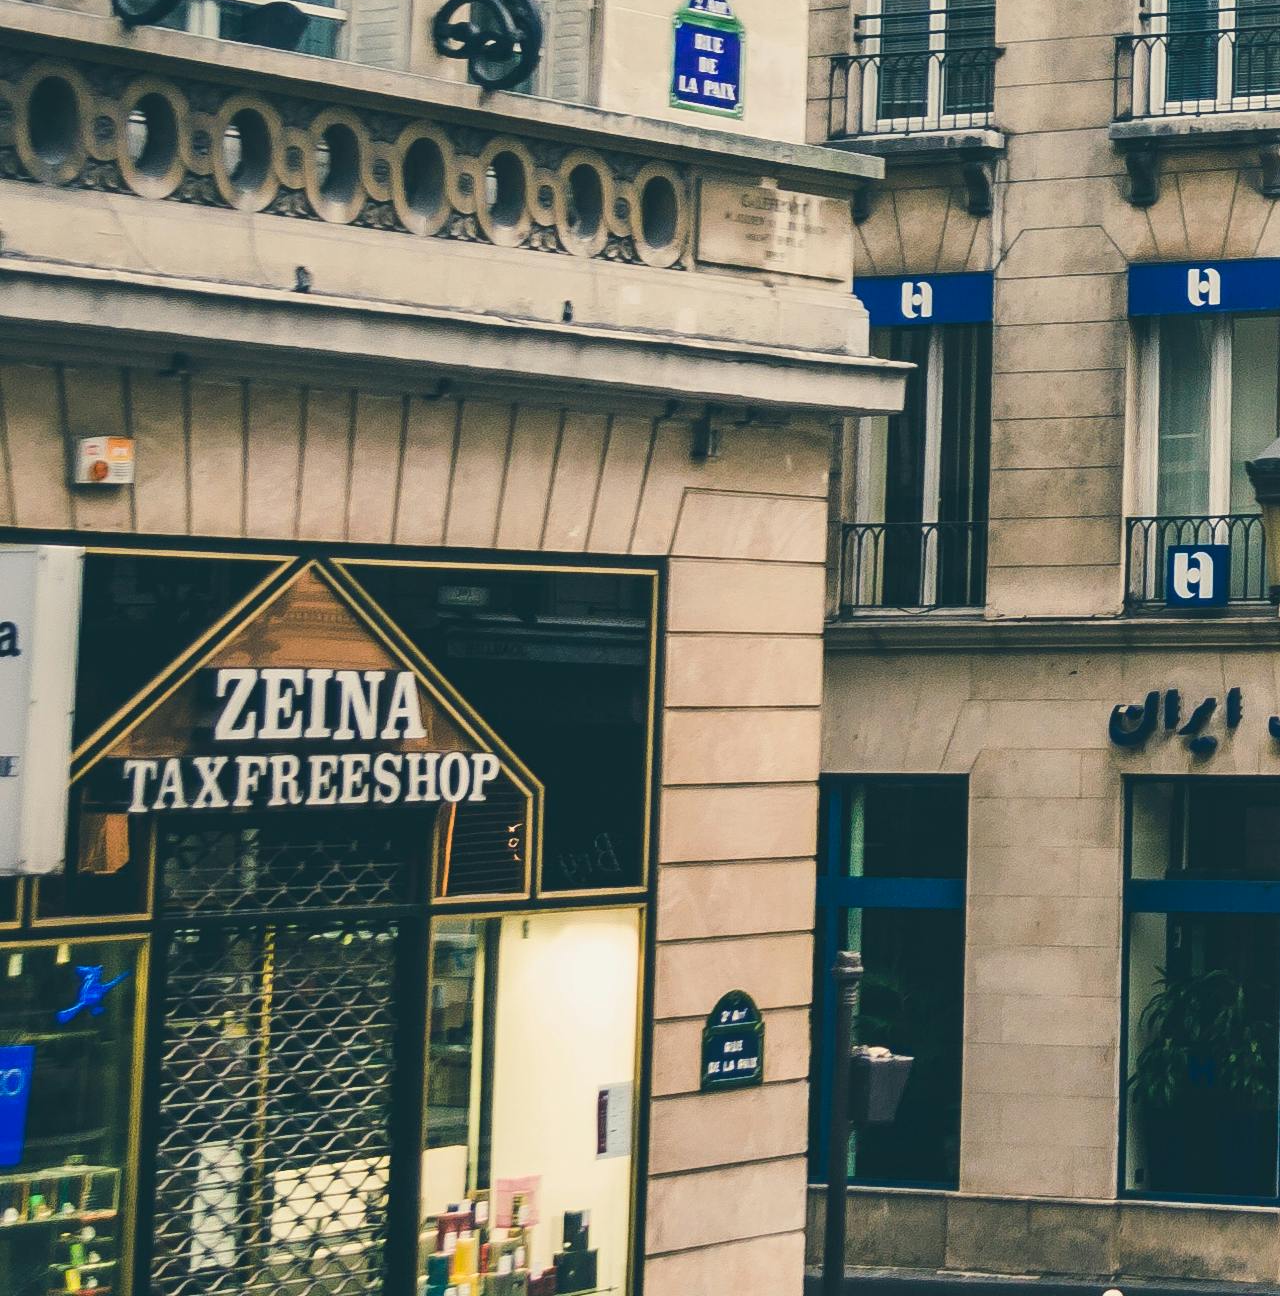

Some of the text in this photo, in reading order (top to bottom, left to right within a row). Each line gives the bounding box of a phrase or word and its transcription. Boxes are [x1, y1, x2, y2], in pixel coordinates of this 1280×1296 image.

[678, 75, 736, 100] LA PAIX
[214, 668, 428, 741] ZEINA
